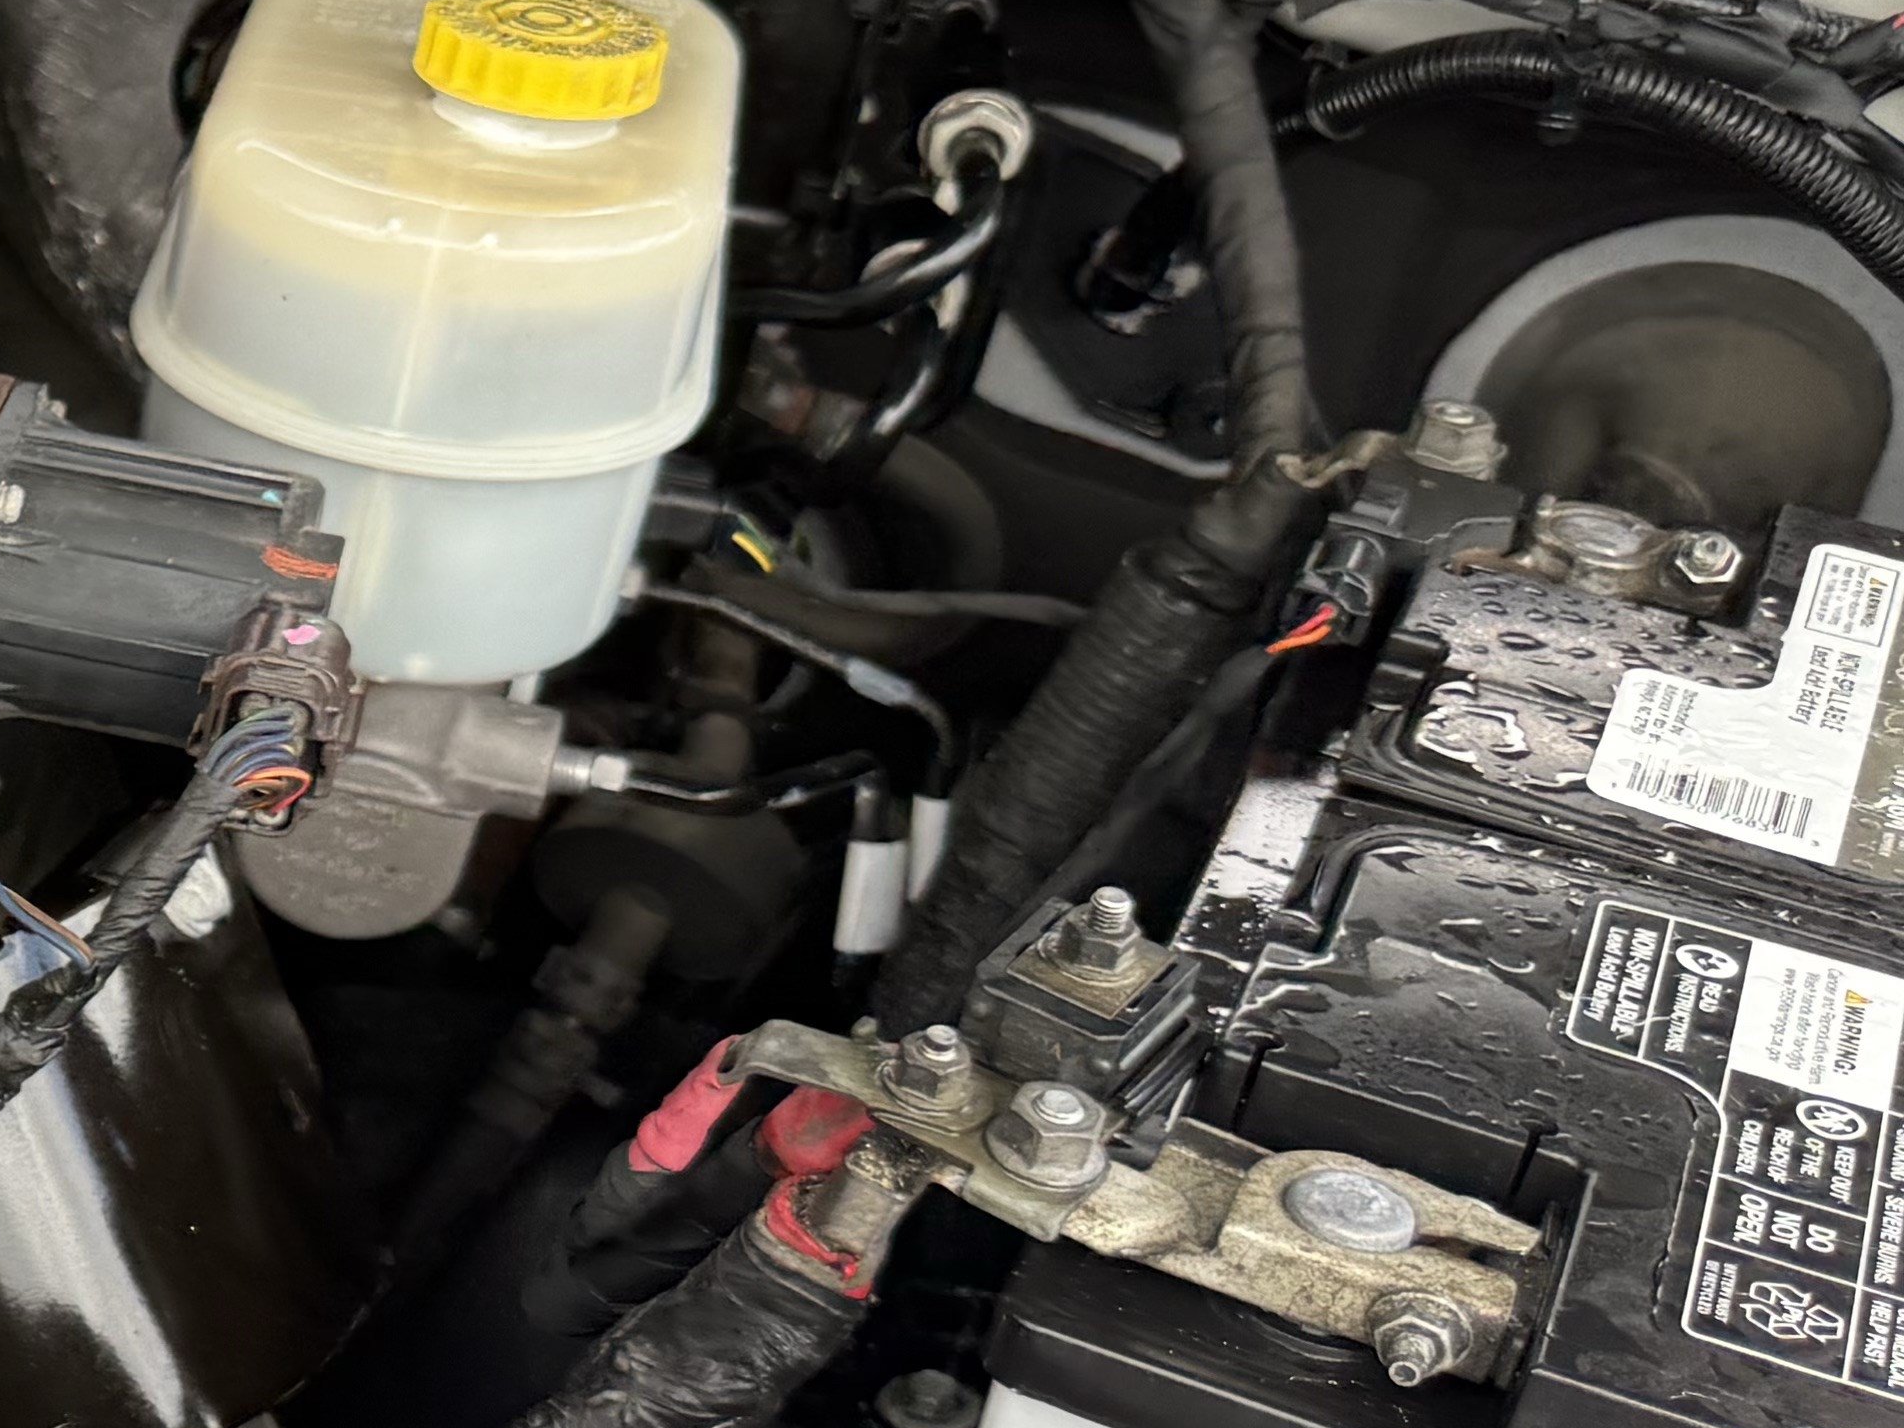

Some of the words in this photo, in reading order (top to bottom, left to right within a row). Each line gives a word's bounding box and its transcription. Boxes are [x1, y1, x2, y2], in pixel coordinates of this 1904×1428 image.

[1602, 926, 1629, 954] Lead
[1598, 953, 1620, 979] Acid
[1610, 927, 1658, 1033] NON-SPILLABLE
[1583, 978, 1617, 1022] Battery
[1699, 980, 1723, 1013] READ
[1832, 1004, 1866, 1077] WARNING:
[1769, 1127, 1795, 1169] REACH
[1804, 1137, 1826, 1156] OF
[1833, 1145, 1857, 1175] KEEP
[1799, 1154, 1823, 1179] THE
[1828, 1174, 1853, 1204] OUT
[1733, 1193, 1769, 1245] OPEN.
[1769, 1209, 1803, 1250] NOT
[1805, 1223, 1837, 1254] DO
[1870, 1298, 1893, 1335] HELP
